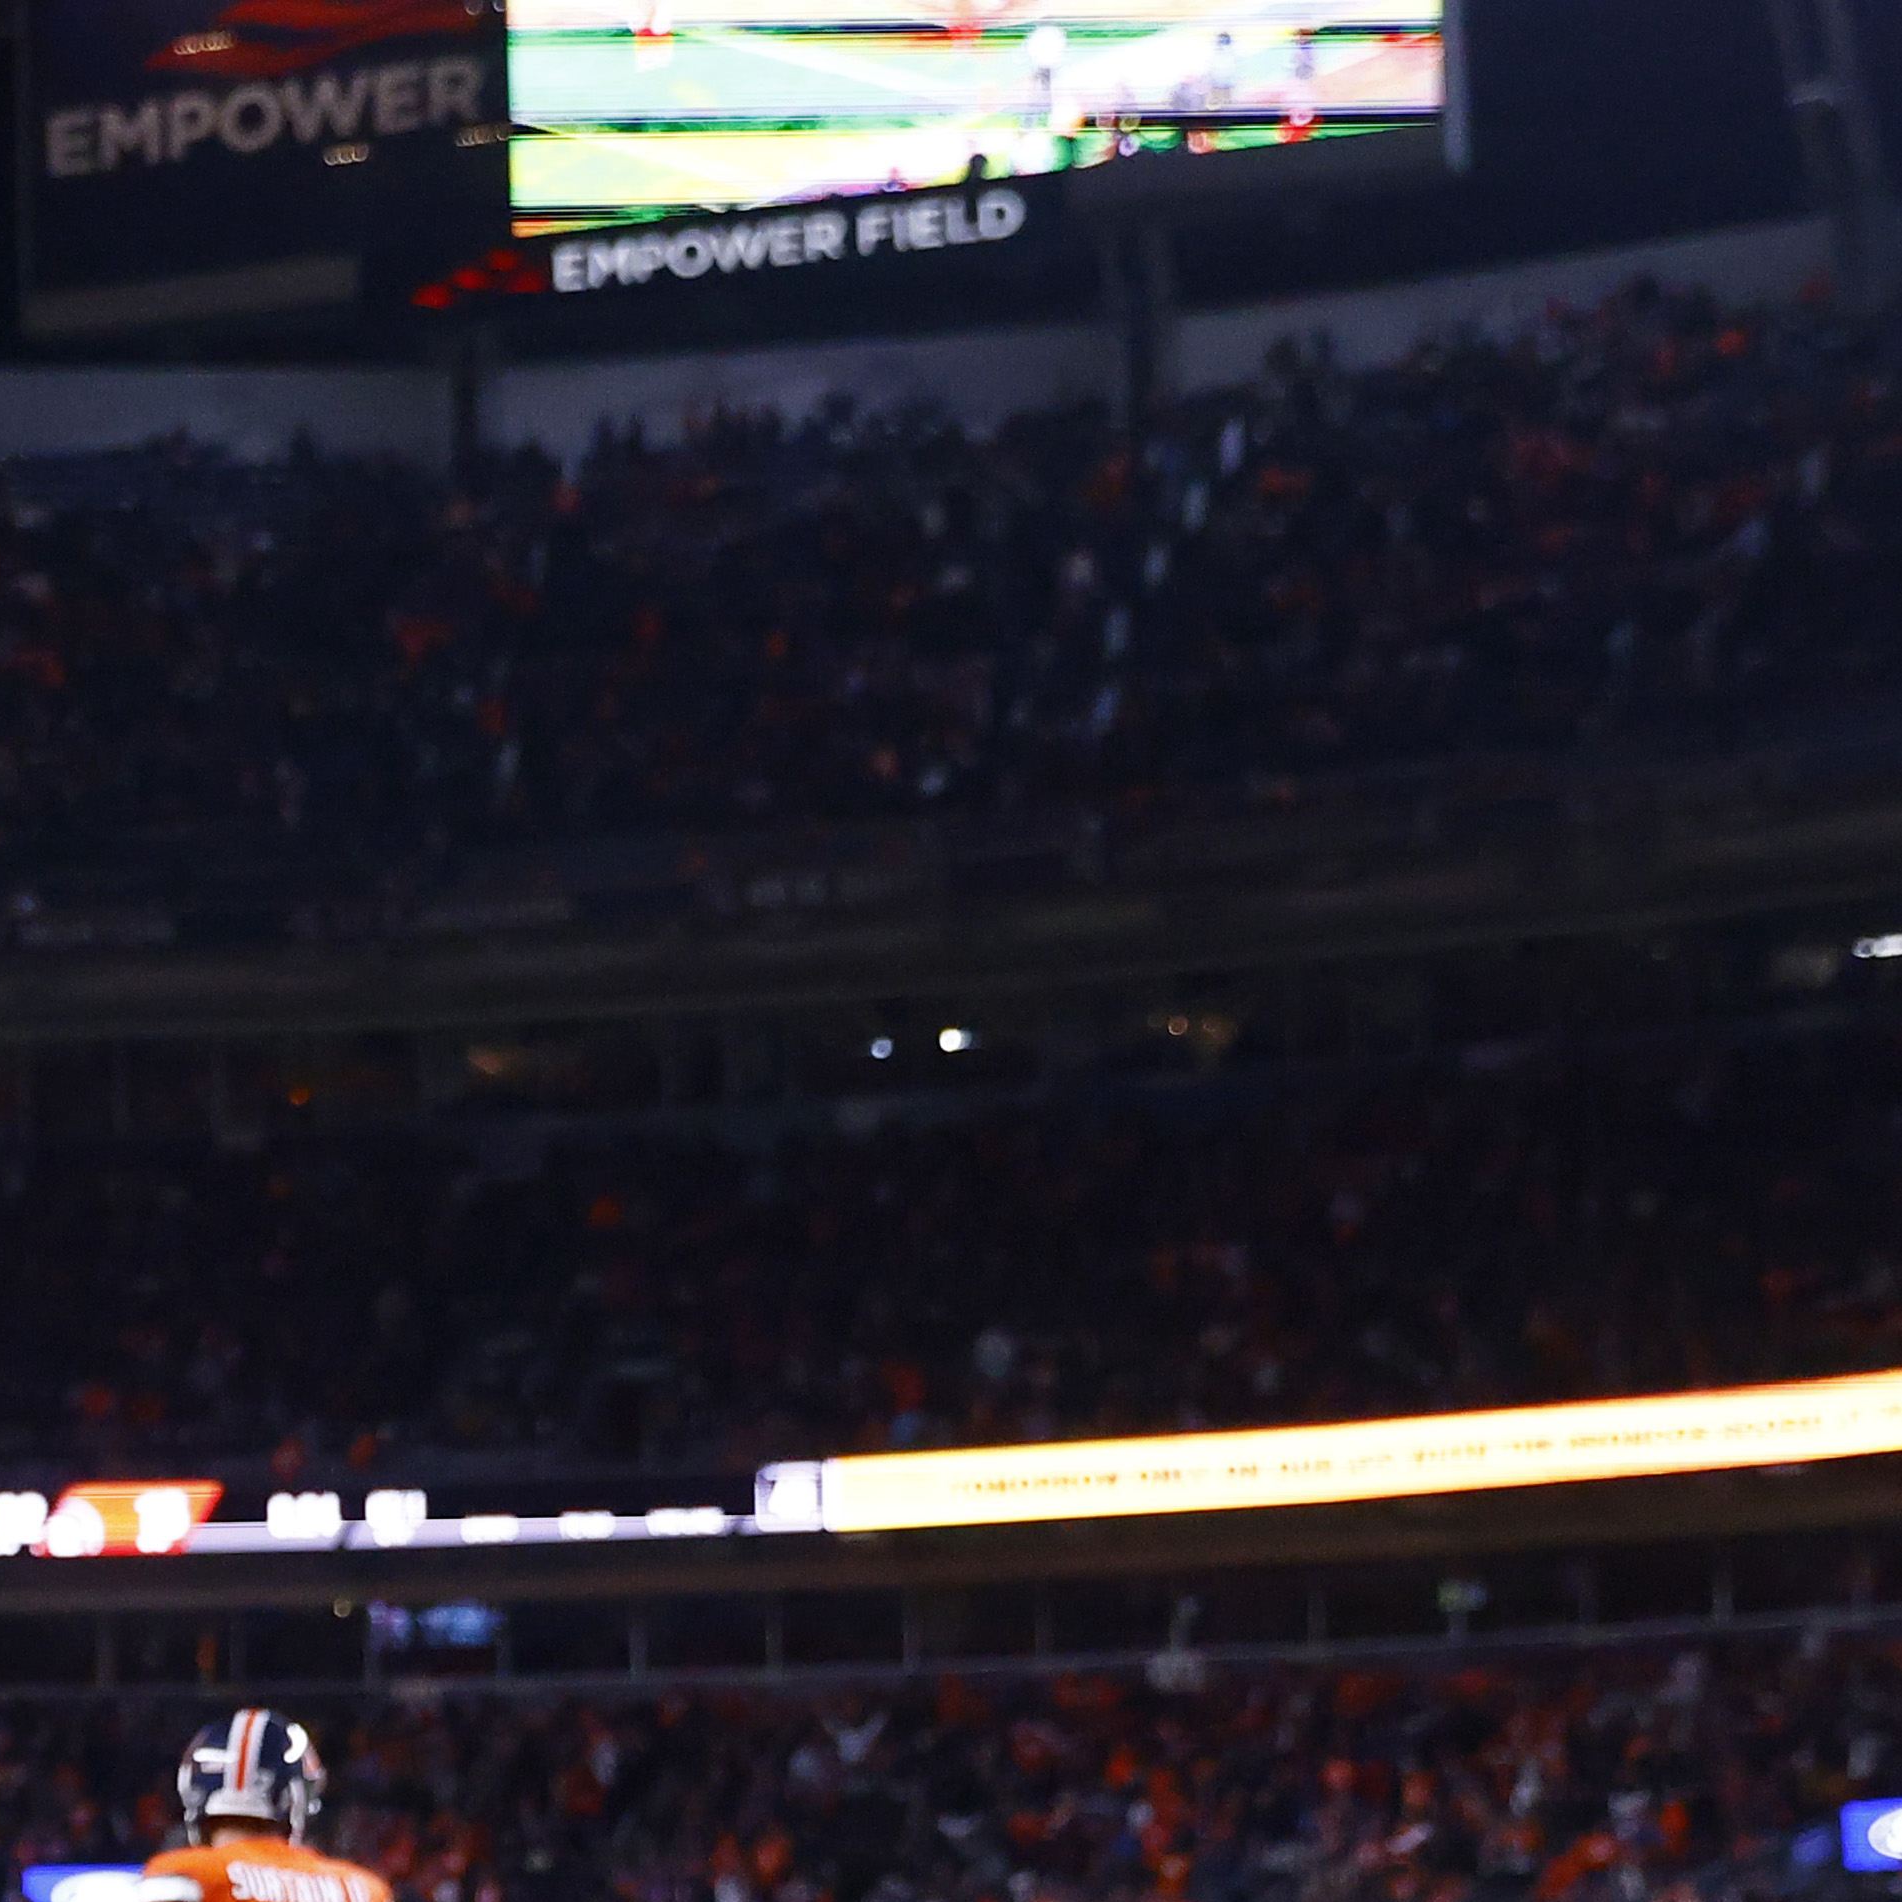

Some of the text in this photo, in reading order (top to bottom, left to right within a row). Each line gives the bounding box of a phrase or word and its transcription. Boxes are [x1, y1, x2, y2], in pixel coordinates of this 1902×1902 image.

[45, 55, 482, 178] EMPOWER
[551, 187, 1027, 294] EMPOWER FIELD
